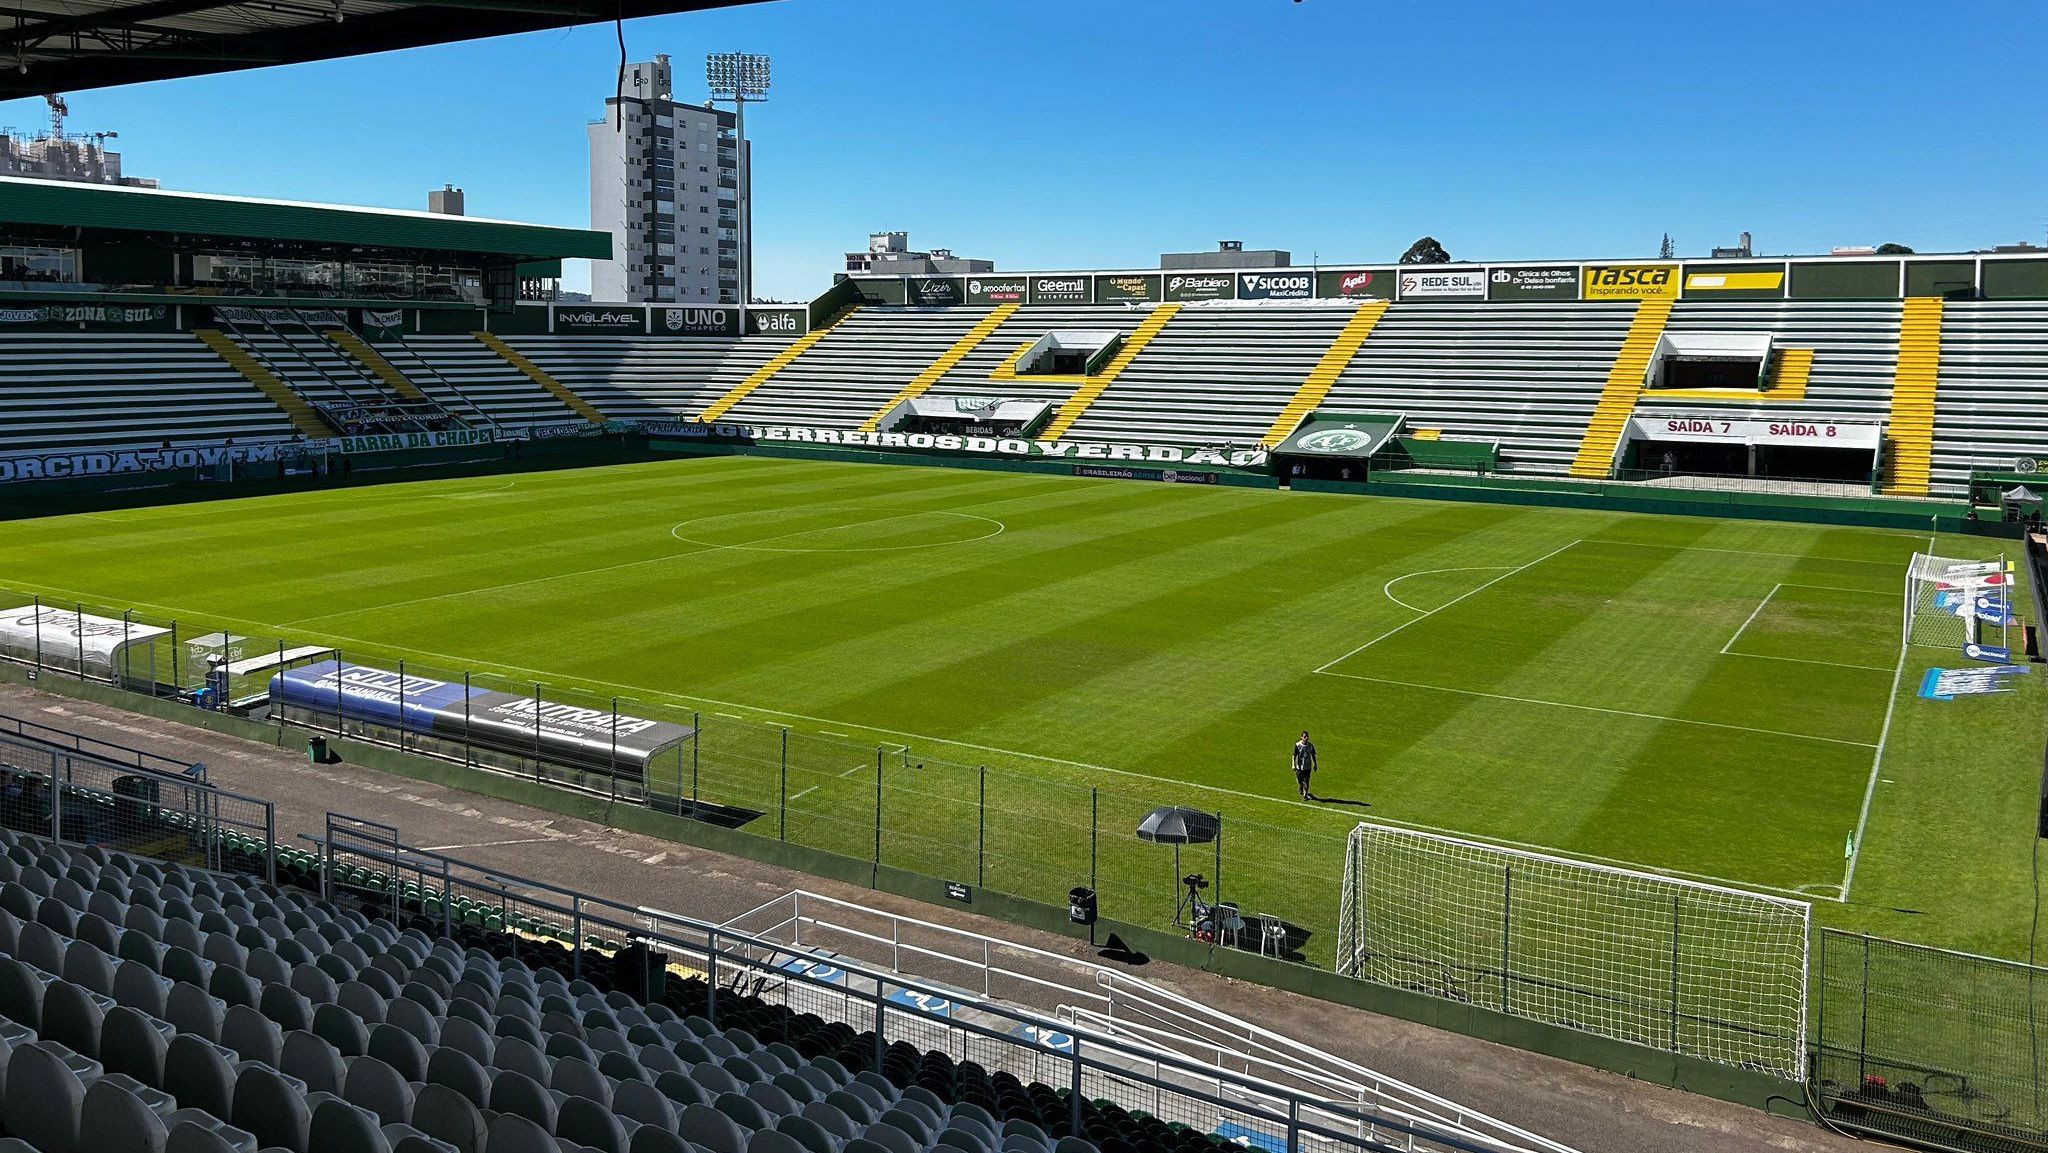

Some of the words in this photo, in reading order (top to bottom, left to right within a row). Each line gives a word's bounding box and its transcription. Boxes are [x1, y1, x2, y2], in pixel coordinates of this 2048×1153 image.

[1038, 279, 1084, 292] Geemil
[1184, 278, 1230, 288] Barbiero
[1259, 277, 1309, 289] SICOOB
[1421, 278, 1448, 286] REDE
[1451, 276, 1472, 286] SUL
[1590, 287, 1638, 296] Inspirando
[65, 307, 106, 321] ZONA
[124, 308, 153, 321] SUL
[685, 309, 727, 325] UNO
[965, 426, 994, 434] BEBIDAS
[1667, 419, 1713, 433] SAÍDA
[1721, 422, 1731, 434] 7
[1769, 421, 1817, 437] SAÍDA
[1825, 425, 1837, 437] 8
[341, 433, 403, 453] BARRA
[408, 431, 432, 447] DA
[715, 424, 962, 449] GUERREIROS
[964, 437, 1031, 455] DO
[500, 697, 657, 730] NUTRATA
